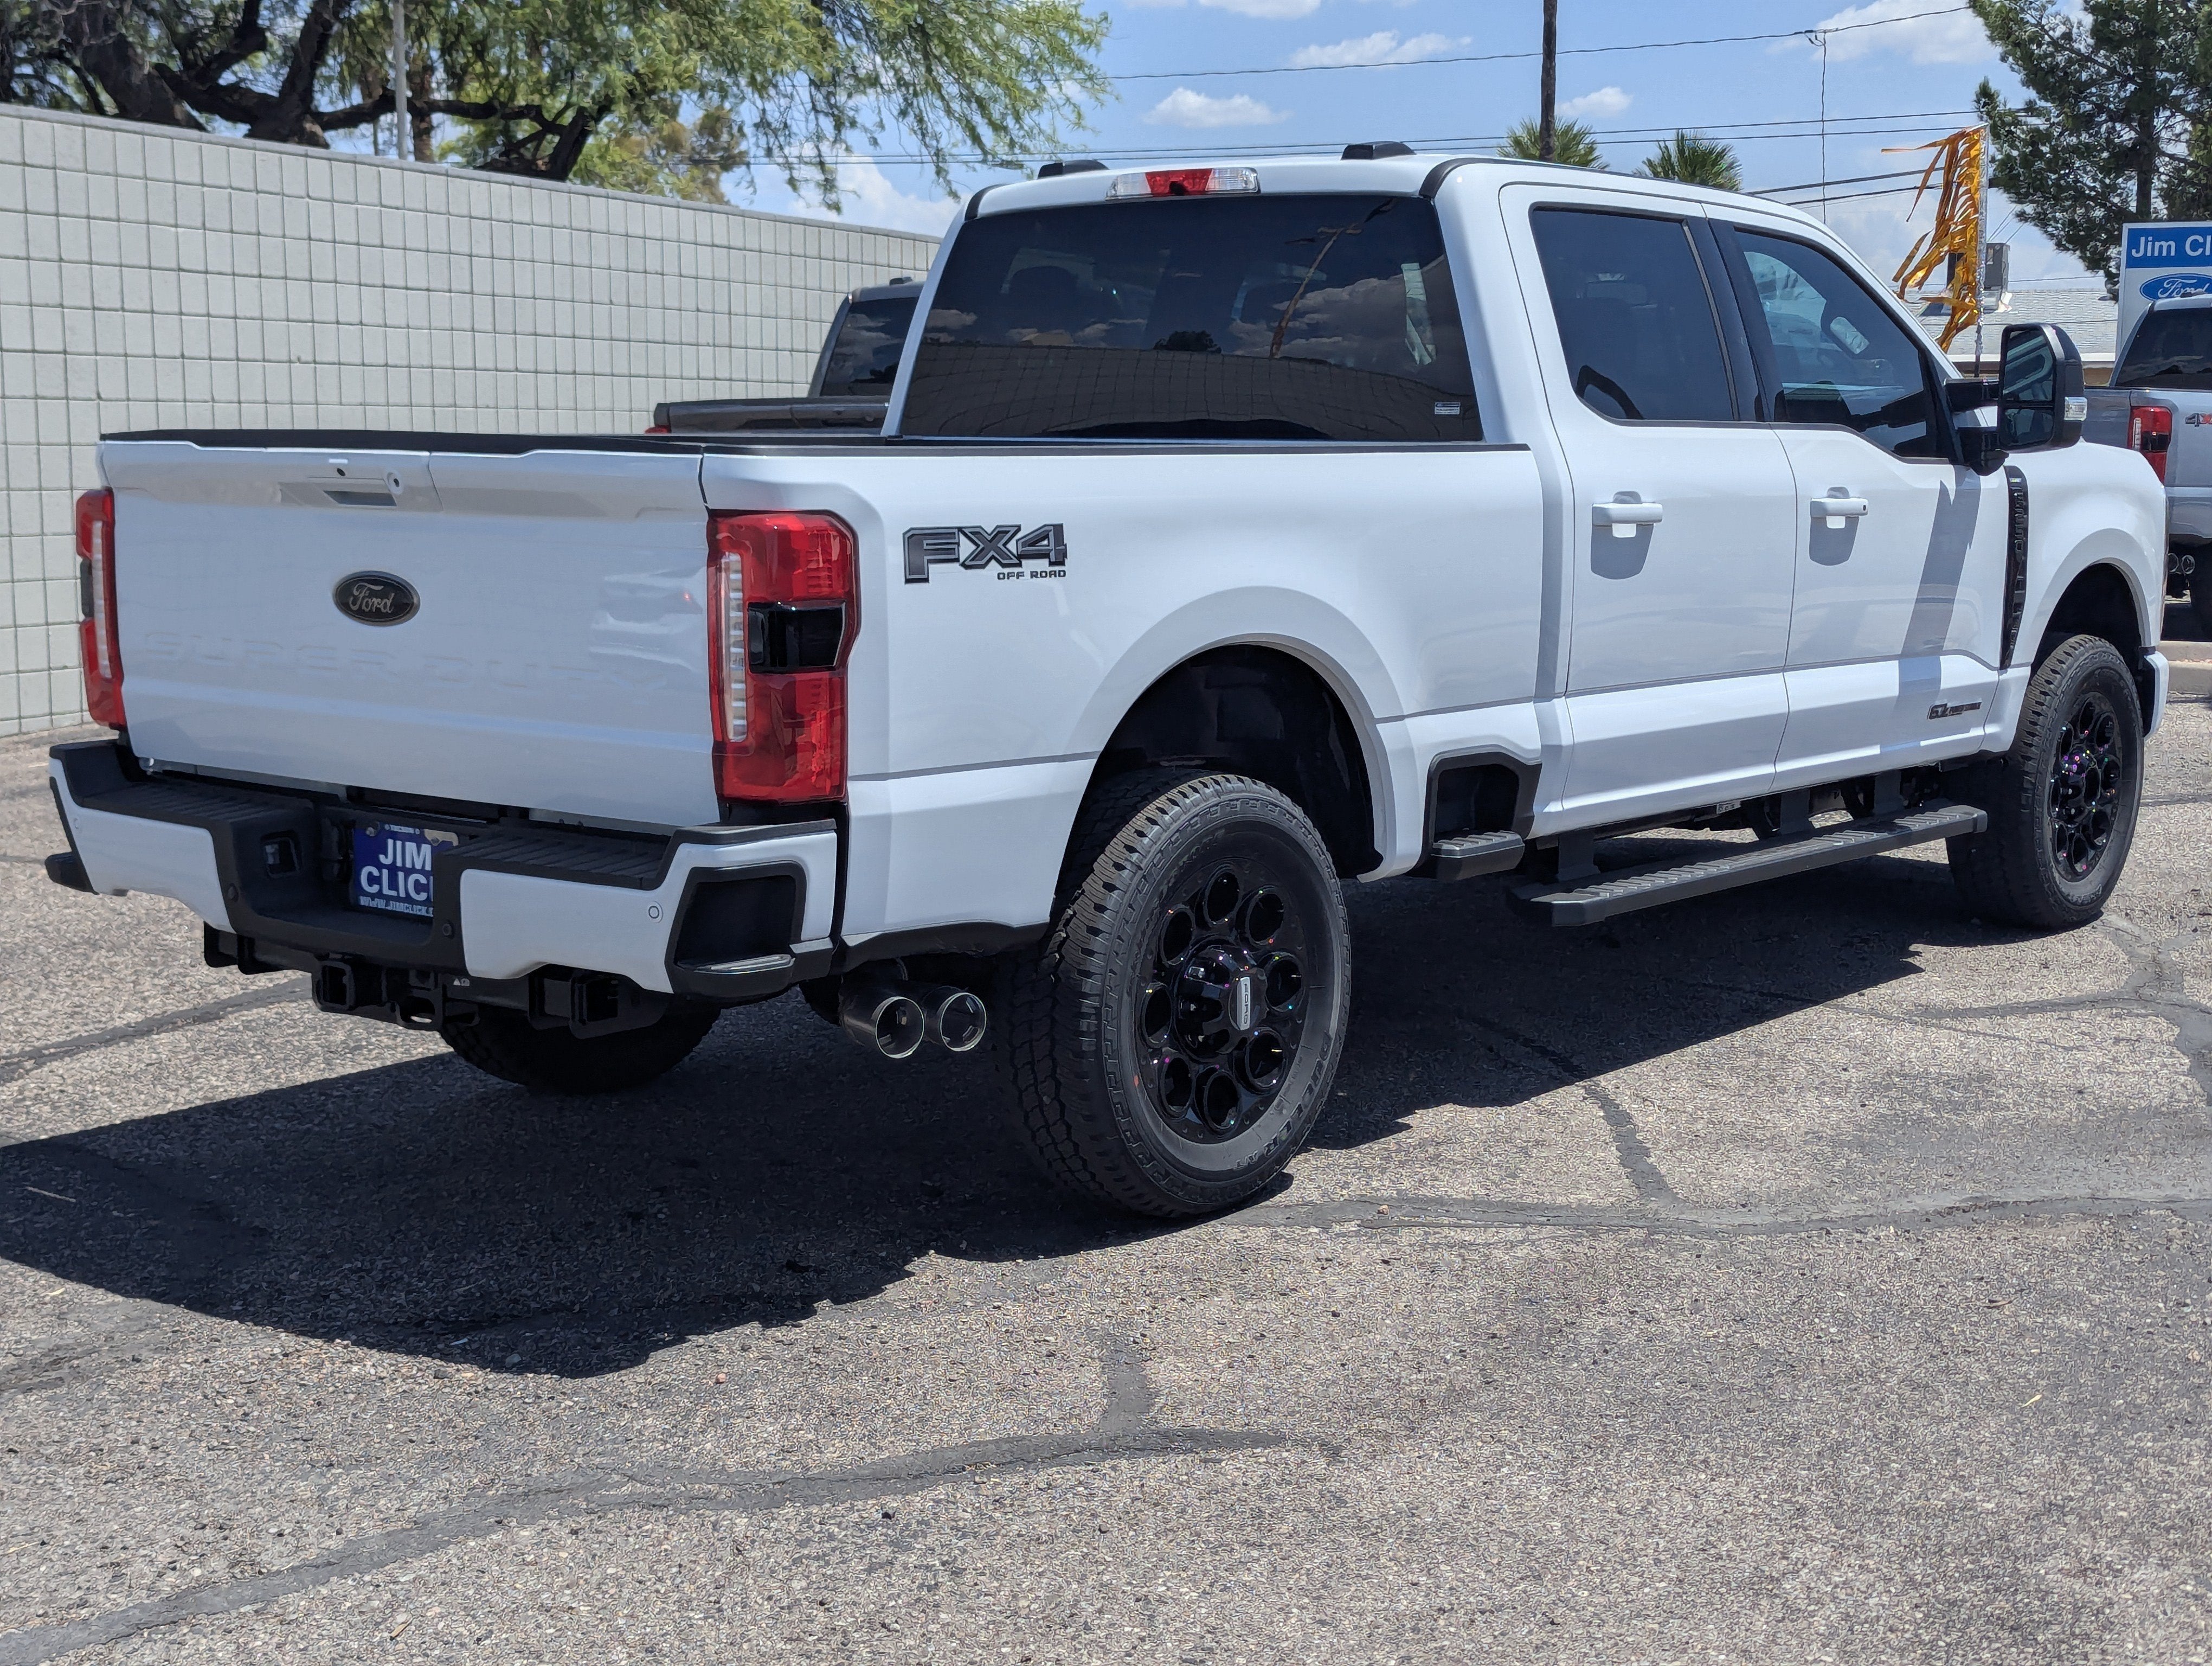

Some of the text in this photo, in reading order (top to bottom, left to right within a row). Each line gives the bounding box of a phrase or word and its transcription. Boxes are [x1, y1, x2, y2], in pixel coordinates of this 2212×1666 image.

[2131, 236, 2176, 258] Jim
[902, 523, 1068, 585] FX4
[997, 569, 1066, 580] OFF ROAD
[349, 582, 395, 613] Ford
[379, 838, 432, 871] JIM
[361, 866, 433, 902] CLIC
